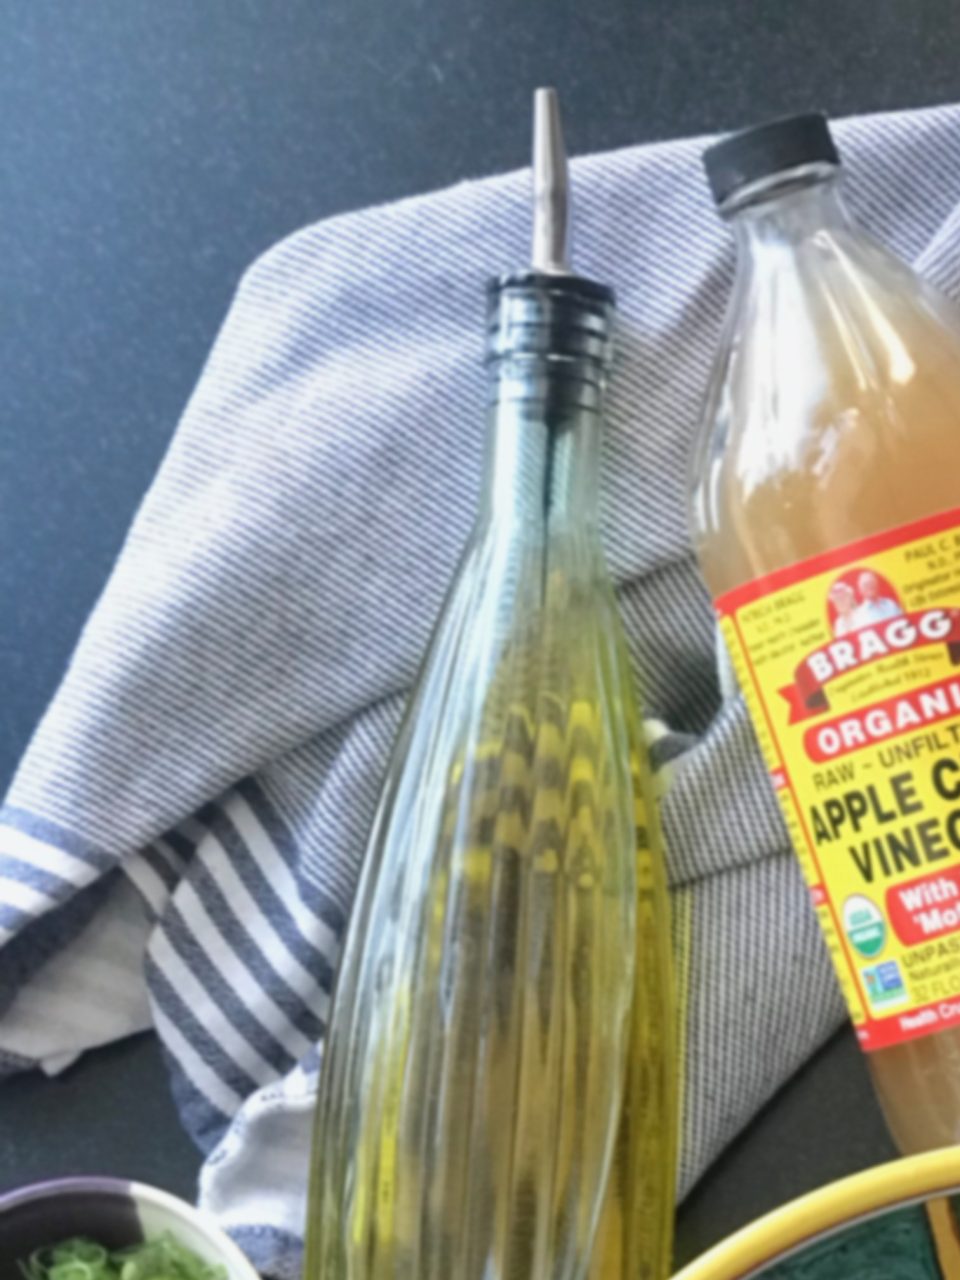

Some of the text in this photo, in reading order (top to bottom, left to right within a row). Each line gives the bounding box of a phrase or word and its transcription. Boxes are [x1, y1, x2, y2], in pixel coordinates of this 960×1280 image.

[807, 610, 953, 683] BRAGG
[812, 762, 856, 792] RAW
[810, 771, 924, 847] APPLE
[899, 877, 959, 913] With
